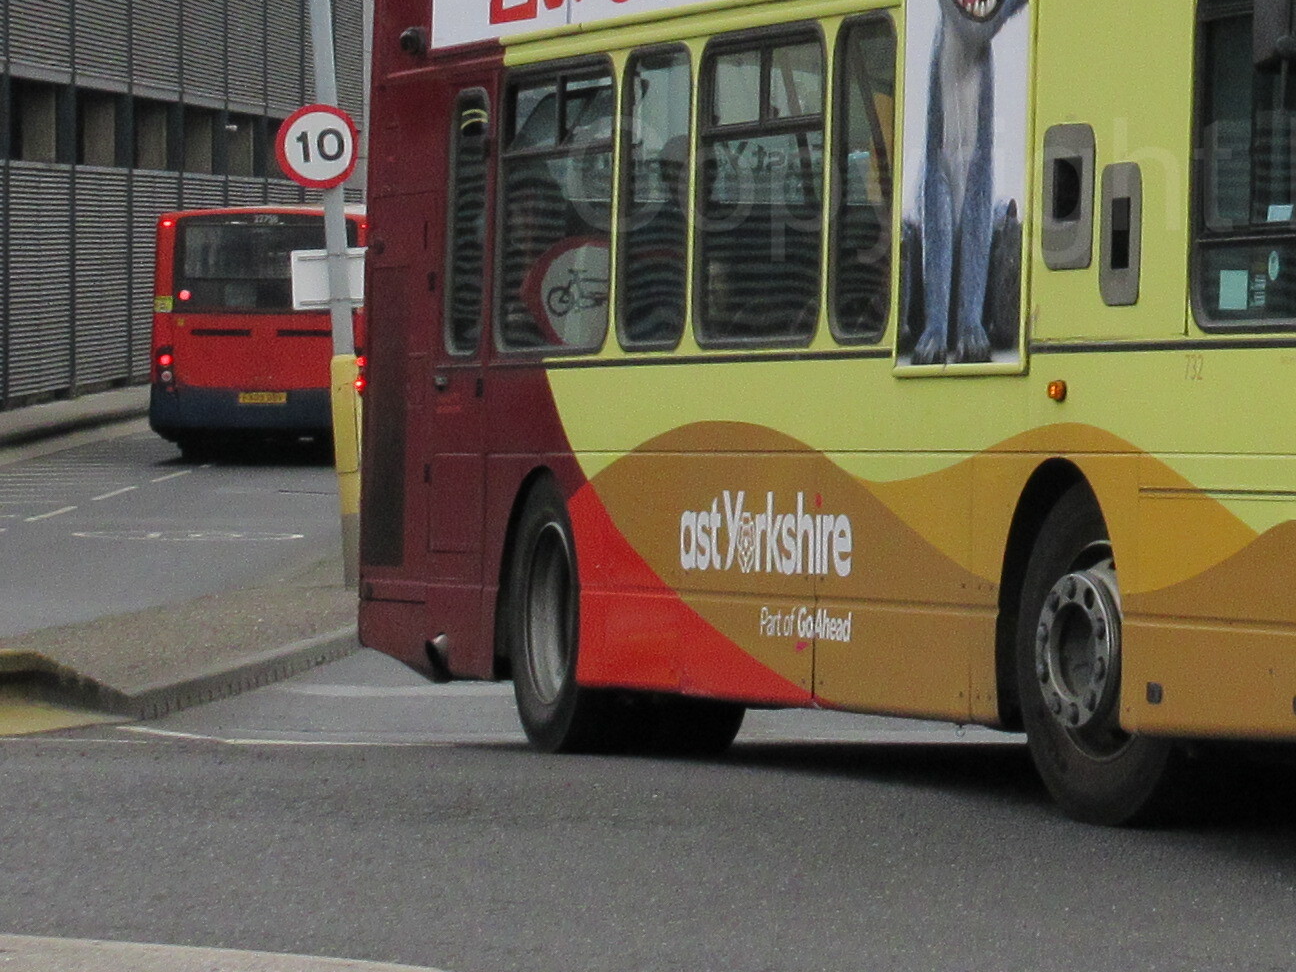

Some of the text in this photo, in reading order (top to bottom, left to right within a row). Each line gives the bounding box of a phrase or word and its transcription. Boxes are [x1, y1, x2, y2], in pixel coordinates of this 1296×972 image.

[296, 128, 345, 163] 10
[759, 606, 782, 637] Part
[783, 606, 796, 637] of
